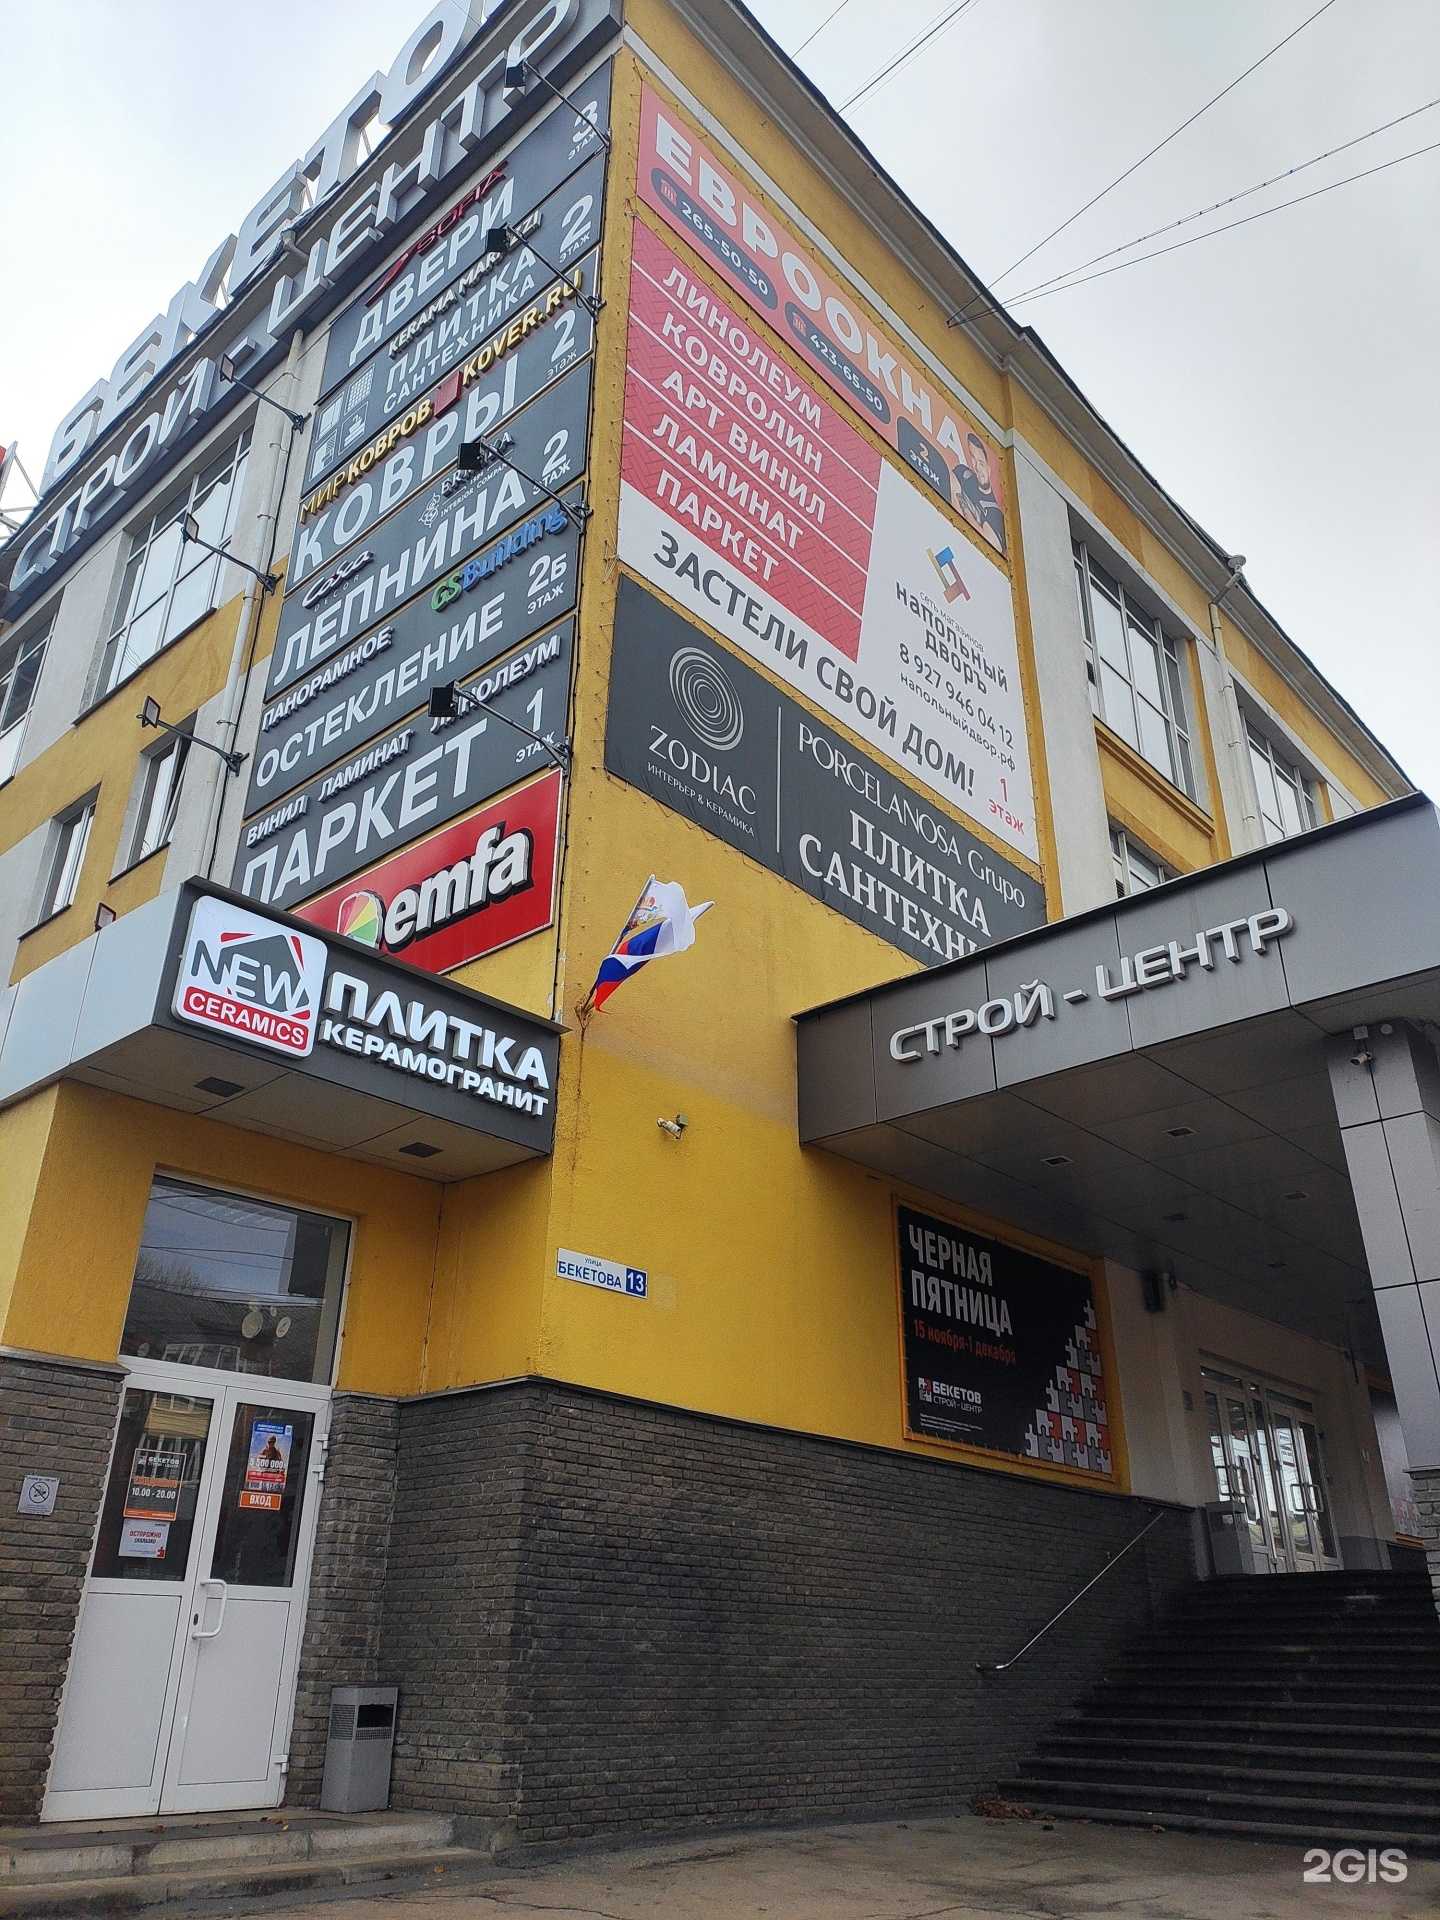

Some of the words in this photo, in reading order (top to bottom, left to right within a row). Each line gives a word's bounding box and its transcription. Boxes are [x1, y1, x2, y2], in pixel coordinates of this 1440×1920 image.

[574, 101, 598, 142] 3
[39, 0, 505, 496] БЕКЕТО
[559, 235, 591, 263] ЭТАЖ
[560, 194, 593, 253] 2
[681, 202, 768, 295] 265-50-50
[348, 176, 514, 367] ДВЕРИ
[389, 289, 458, 358] KERAMA
[458, 209, 542, 293] MARZZI
[655, 112, 967, 466] ЕВРООКНА
[384, 274, 535, 414] САНТЕХНИКА
[386, 246, 536, 394] ПЛИТКА
[462, 268, 583, 388] KOVER.RU
[545, 349, 577, 379] этаж
[552, 309, 575, 362] 2
[663, 267, 822, 429] ЛИНОЛЕУМ
[662, 312, 823, 474] КОВРОЛИН
[810, 334, 884, 411] 423-65-50
[293, 353, 518, 584] КОВРЫ
[541, 429, 569, 478] 2
[653, 414, 804, 549] ЛАМИНАТ
[662, 370, 725, 429] АРТ
[728, 422, 826, 524] ВИНИЛ
[910, 449, 940, 486] этаж
[919, 442, 930, 463] 2
[441, 487, 474, 517] INTERIOR
[656, 469, 780, 582] ПАРКЕТ
[274, 469, 526, 686] ЛЕПНИНА
[528, 552, 567, 598] 2Б
[528, 582, 563, 615] ЭТАЖ
[256, 592, 505, 788] ОСТЕКЛЕНИЕ
[261, 625, 394, 732] ПАНОРАМНОЕ
[653, 529, 809, 670] ЗАСТЕЛИ
[816, 656, 898, 738] СВОЙ
[901, 722, 975, 796] ДОМ!
[900, 643, 910, 665] 8
[914, 655, 942, 689] 927
[946, 681, 974, 717] 946
[978, 707, 995, 735] 04
[999, 724, 1014, 750] 12
[516, 732, 554, 763] ЭТАЖ
[526, 688, 543, 733] 1
[901, 672, 1015, 773] напольныйдвор.рф
[242, 718, 487, 904] ПАРКЕТ
[246, 796, 309, 847] ВИНИЛ
[318, 728, 414, 802] ЛАМИНАТ
[647, 762, 696, 798] ИНТЕРЬЕР
[697, 793, 704, 807] &
[706, 800, 755, 838] КЕРАМИКА
[649, 725, 757, 815] ZODIAC
[1000, 778, 1008, 803] 1
[798, 722, 963, 865] PORCELANOSA
[967, 849, 1025, 910] Grupo
[988, 798, 1024, 836] этаж
[849, 809, 992, 937] ПЛИТКА
[188, 992, 305, 1046] CERAMICS
[189, 938, 305, 1012] NEW
[889, 978, 1056, 1062] СТРОЙ
[1096, 908, 1295, 1001] ЦЕНТР
[318, 1019, 549, 1117] КЕРАМОГРАНИТ
[323, 971, 550, 1090] ПЛИТКА
[558, 1260, 622, 1289] БЕКЕТОВА
[627, 1271, 644, 1292] 13
[584, 1256, 602, 1268] улица
[909, 1224, 993, 1287] ЧЕРНАЯ
[911, 1269, 1013, 1337] ПЯТНИЦА
[914, 1319, 926, 1339] 15
[976, 1341, 1016, 1366] декабря
[932, 1381, 982, 1405] БЕКЕТОВ
[132, 1487, 151, 1497] 10.00
[155, 1489, 176, 1499] 20.00
[249, 1494, 272, 1507] ВХОД
